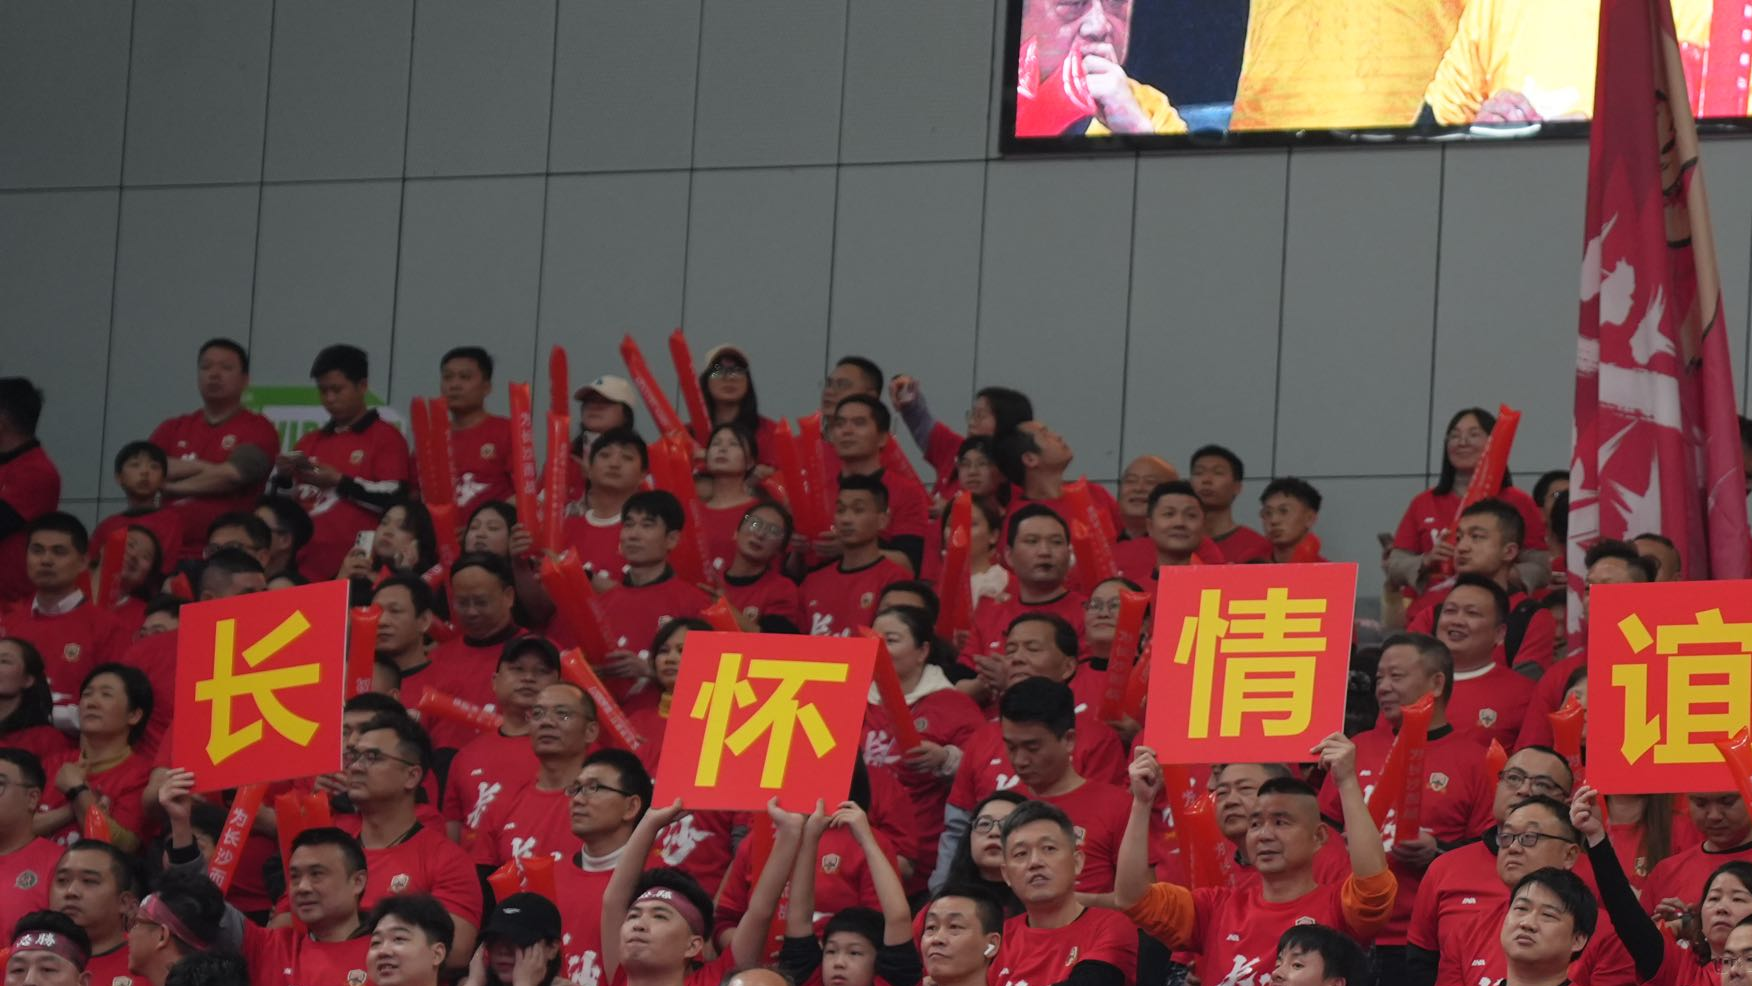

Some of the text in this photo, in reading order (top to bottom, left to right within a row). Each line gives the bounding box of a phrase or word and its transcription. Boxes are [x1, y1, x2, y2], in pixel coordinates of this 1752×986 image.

[194, 610, 321, 765] 长
[690, 653, 849, 788] 怀
[1173, 587, 1327, 737] 情
